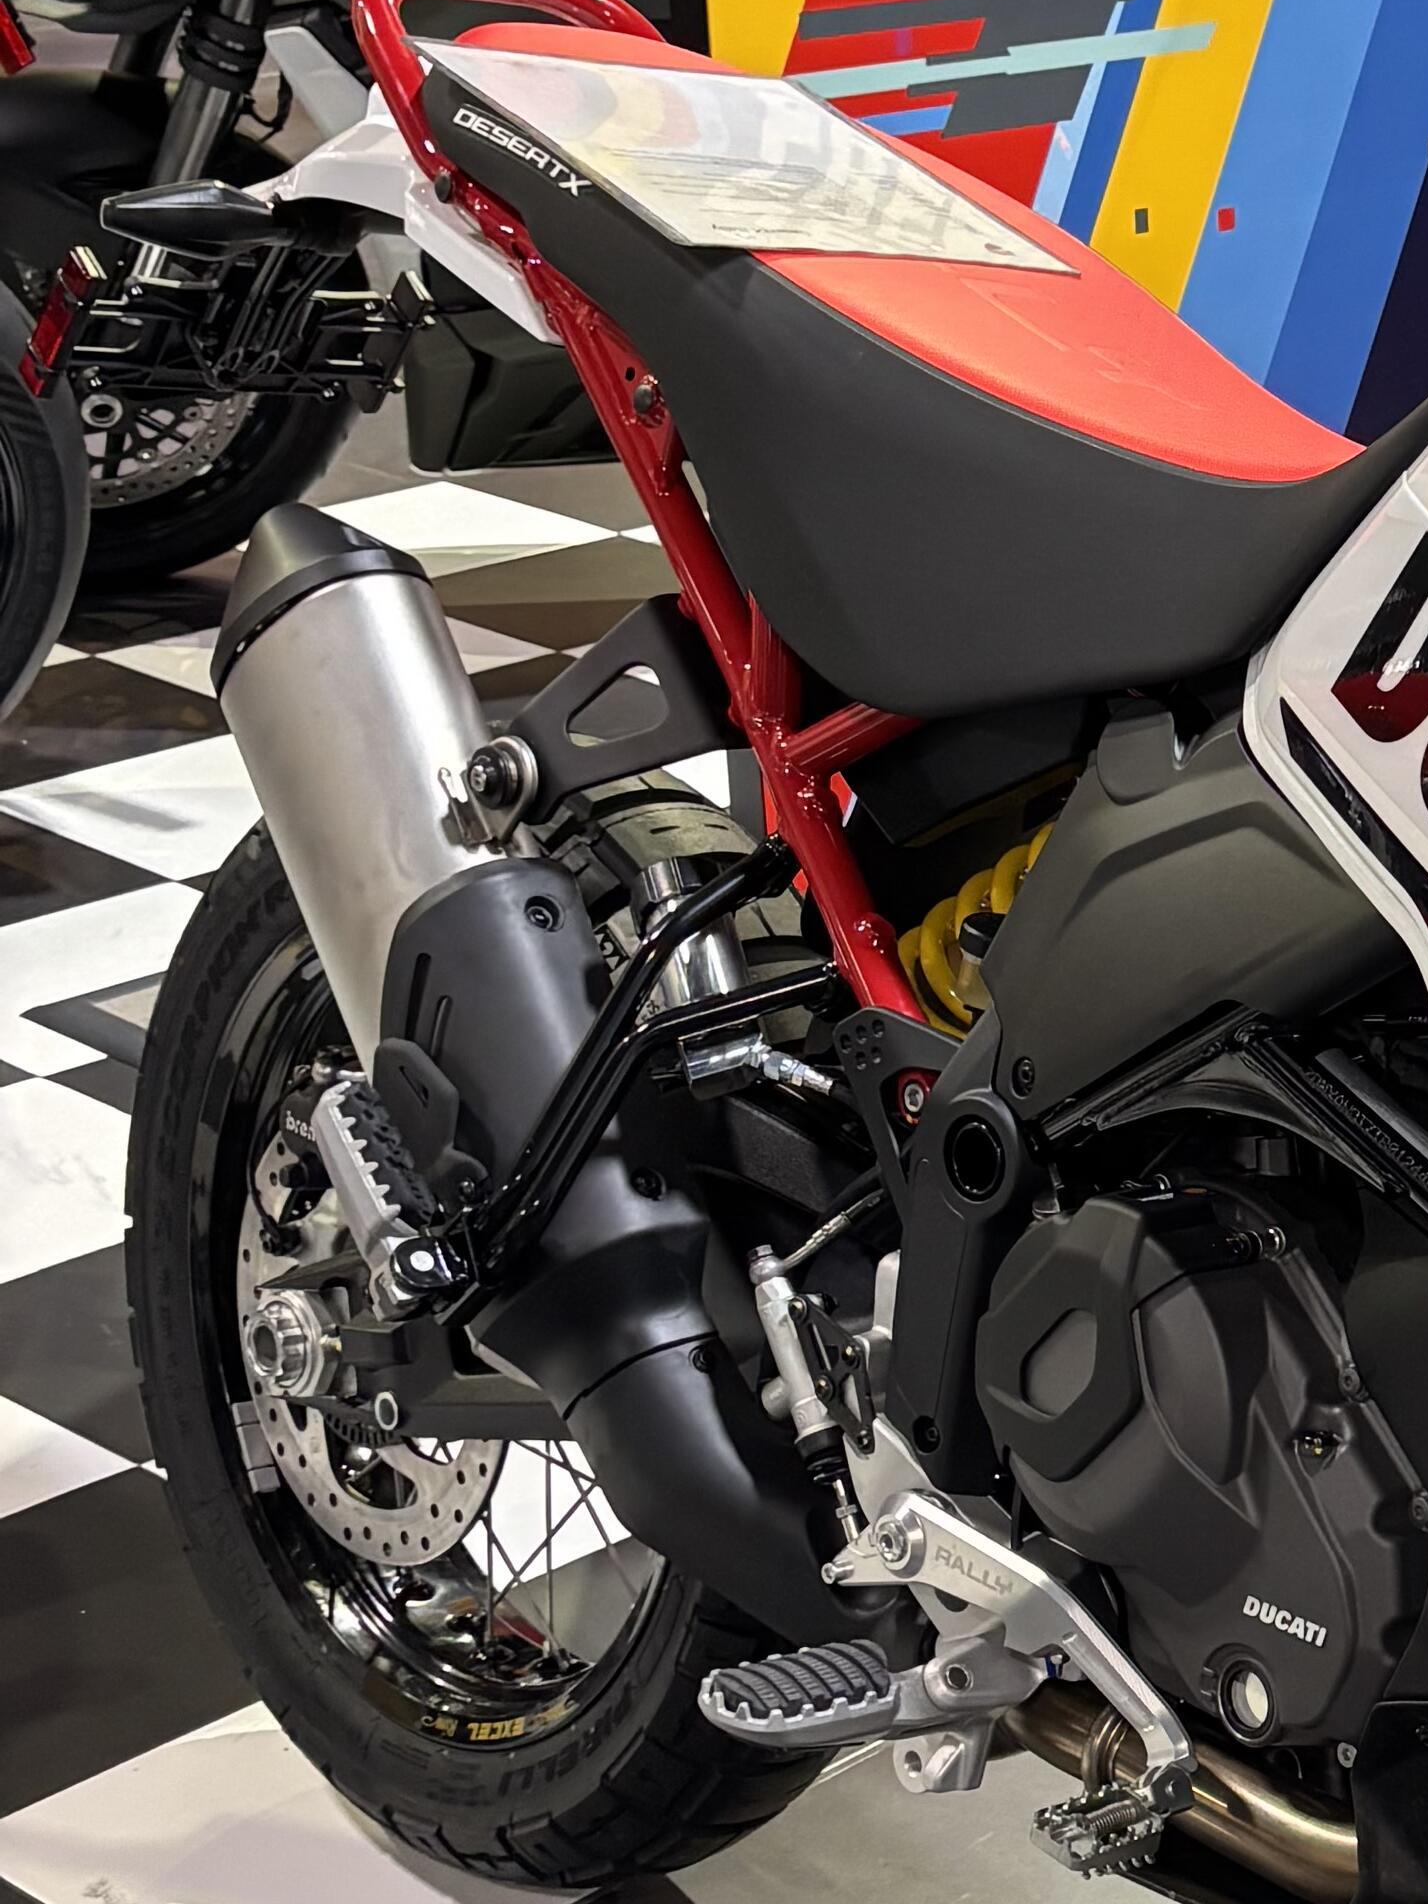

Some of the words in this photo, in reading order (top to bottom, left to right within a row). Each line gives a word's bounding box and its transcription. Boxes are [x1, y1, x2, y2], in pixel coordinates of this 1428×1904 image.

[453, 108, 592, 196] DESERTX
[286, 1110, 317, 1142] brem
[934, 1544, 1014, 1595] RALLY
[1242, 1595, 1328, 1647] DUCATI
[467, 1715, 527, 1741] EXCEL
